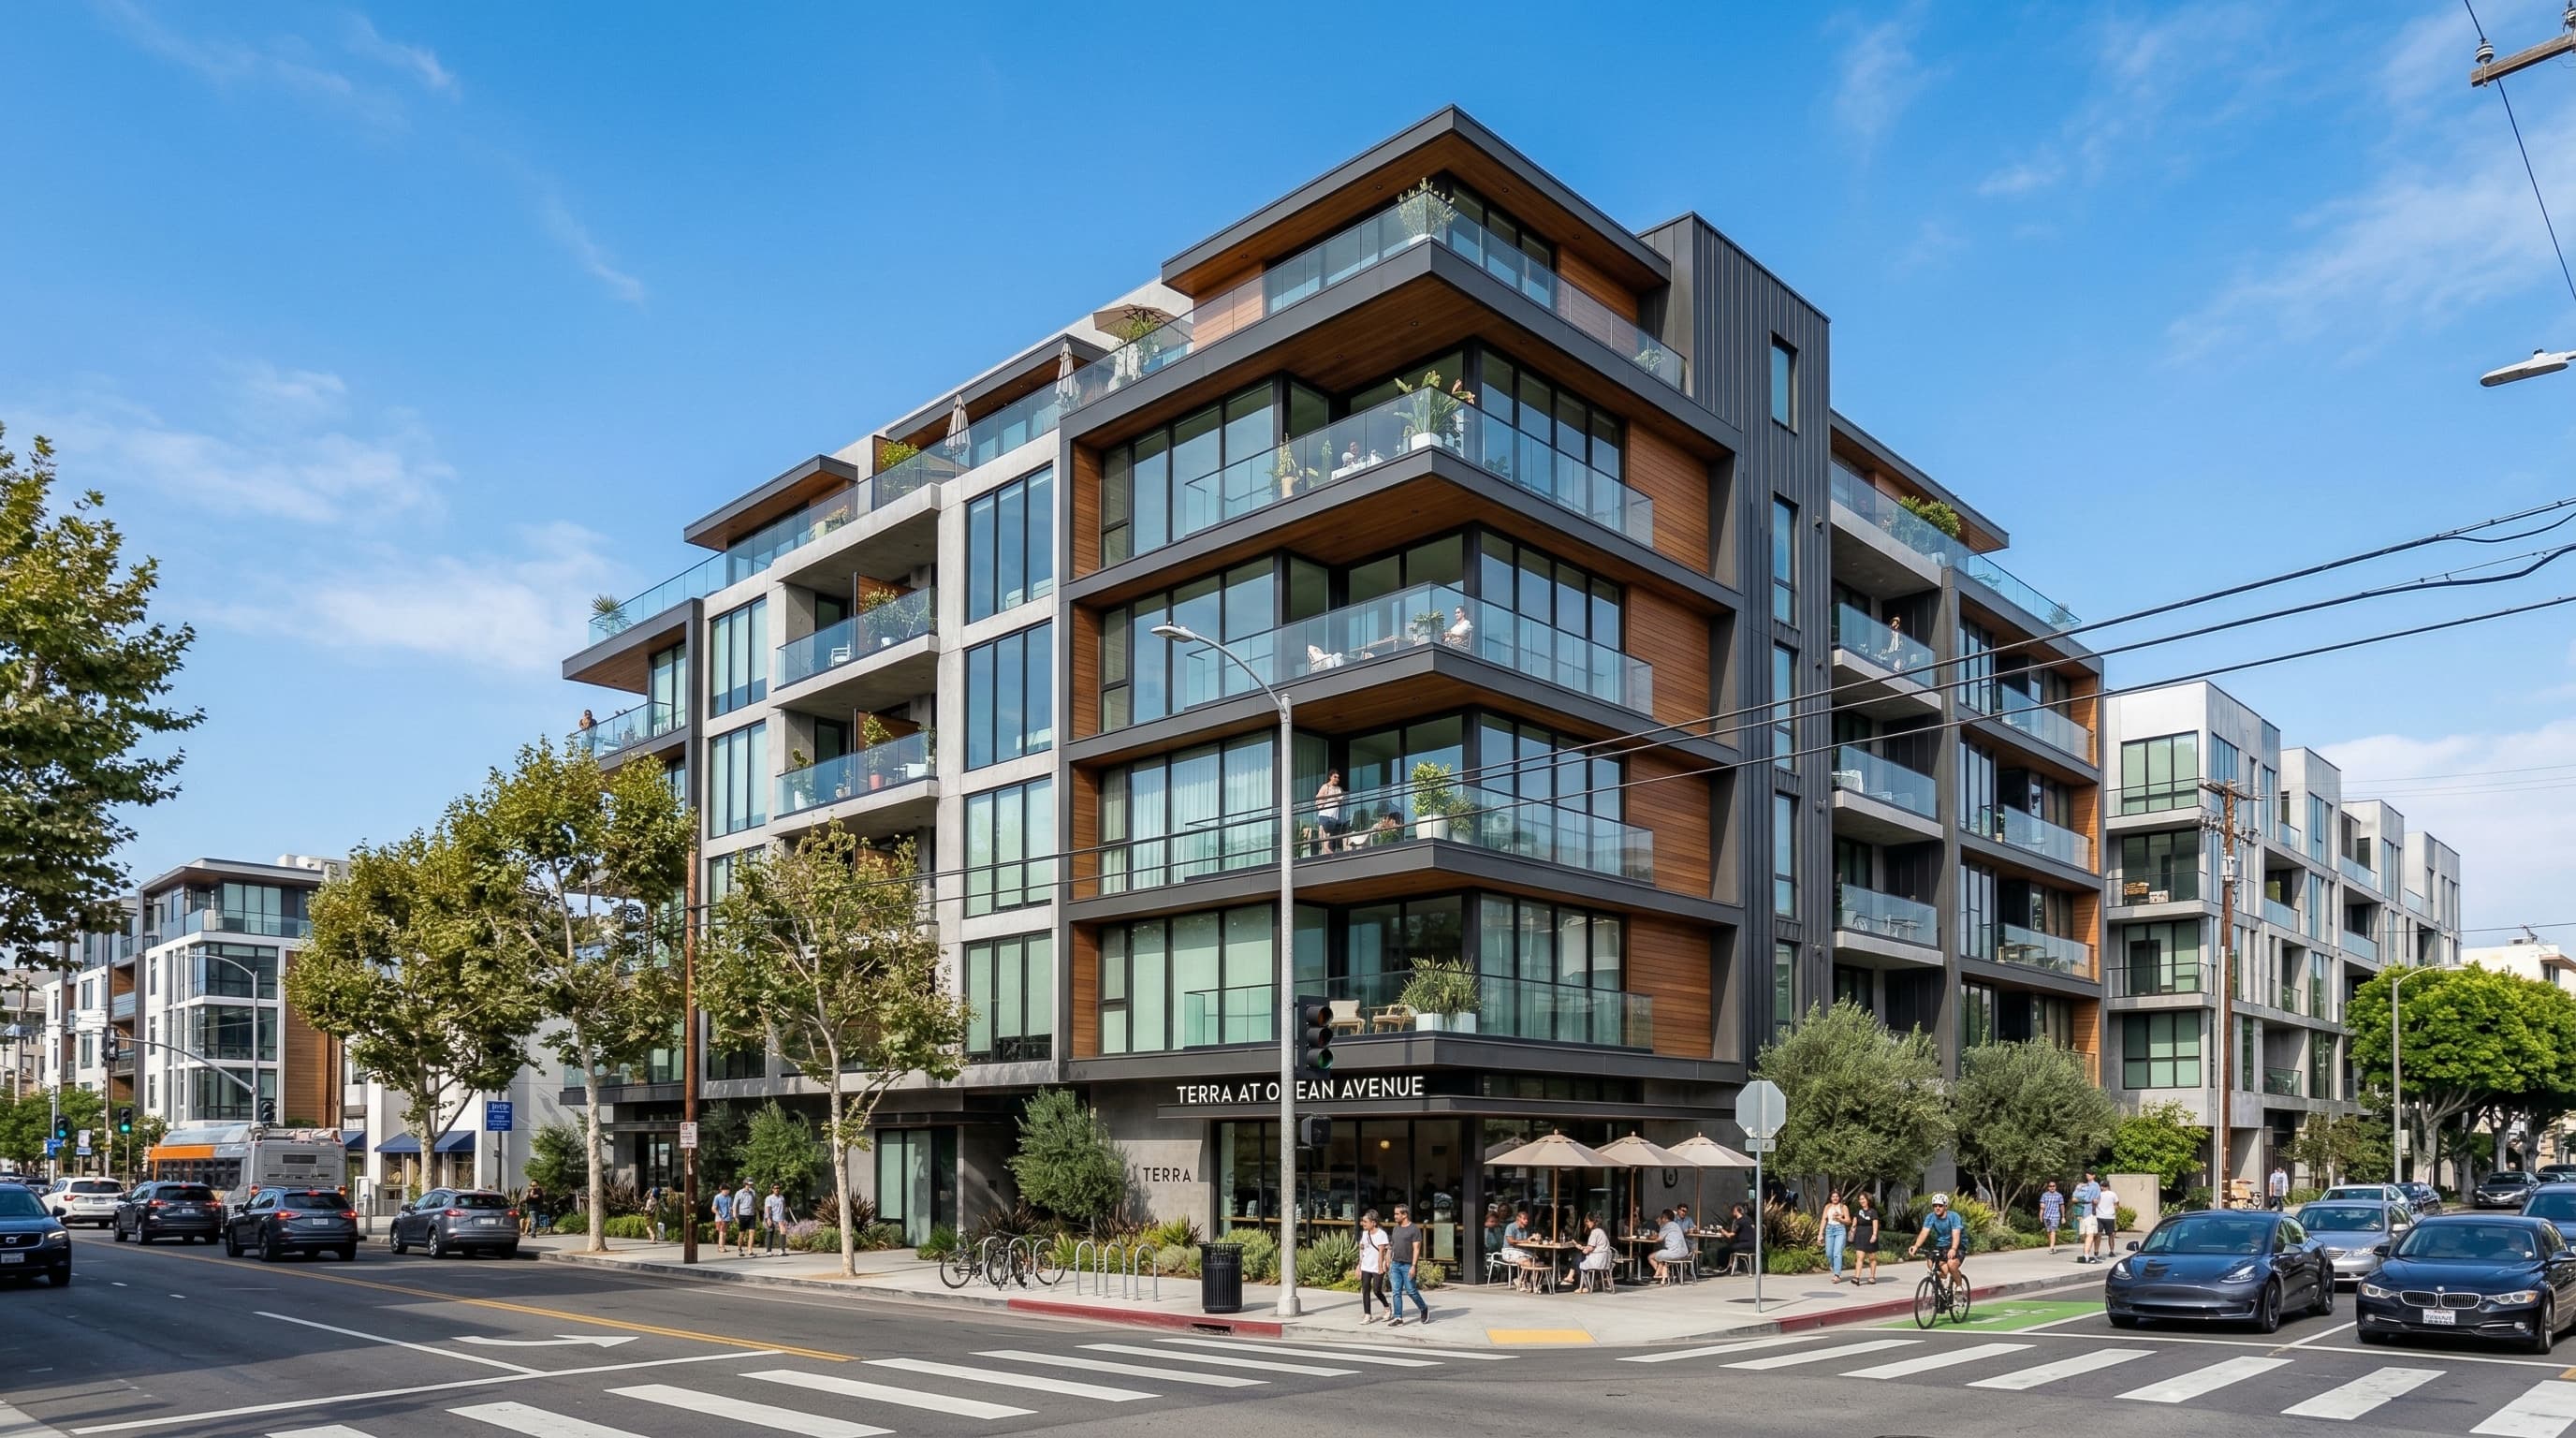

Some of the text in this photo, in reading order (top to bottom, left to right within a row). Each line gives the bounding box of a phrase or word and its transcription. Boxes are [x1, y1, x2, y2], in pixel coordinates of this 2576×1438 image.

[1177, 1076, 1424, 1104] TERRA AT OEAN AVENUE
[1142, 1167, 1192, 1182] TERRA
